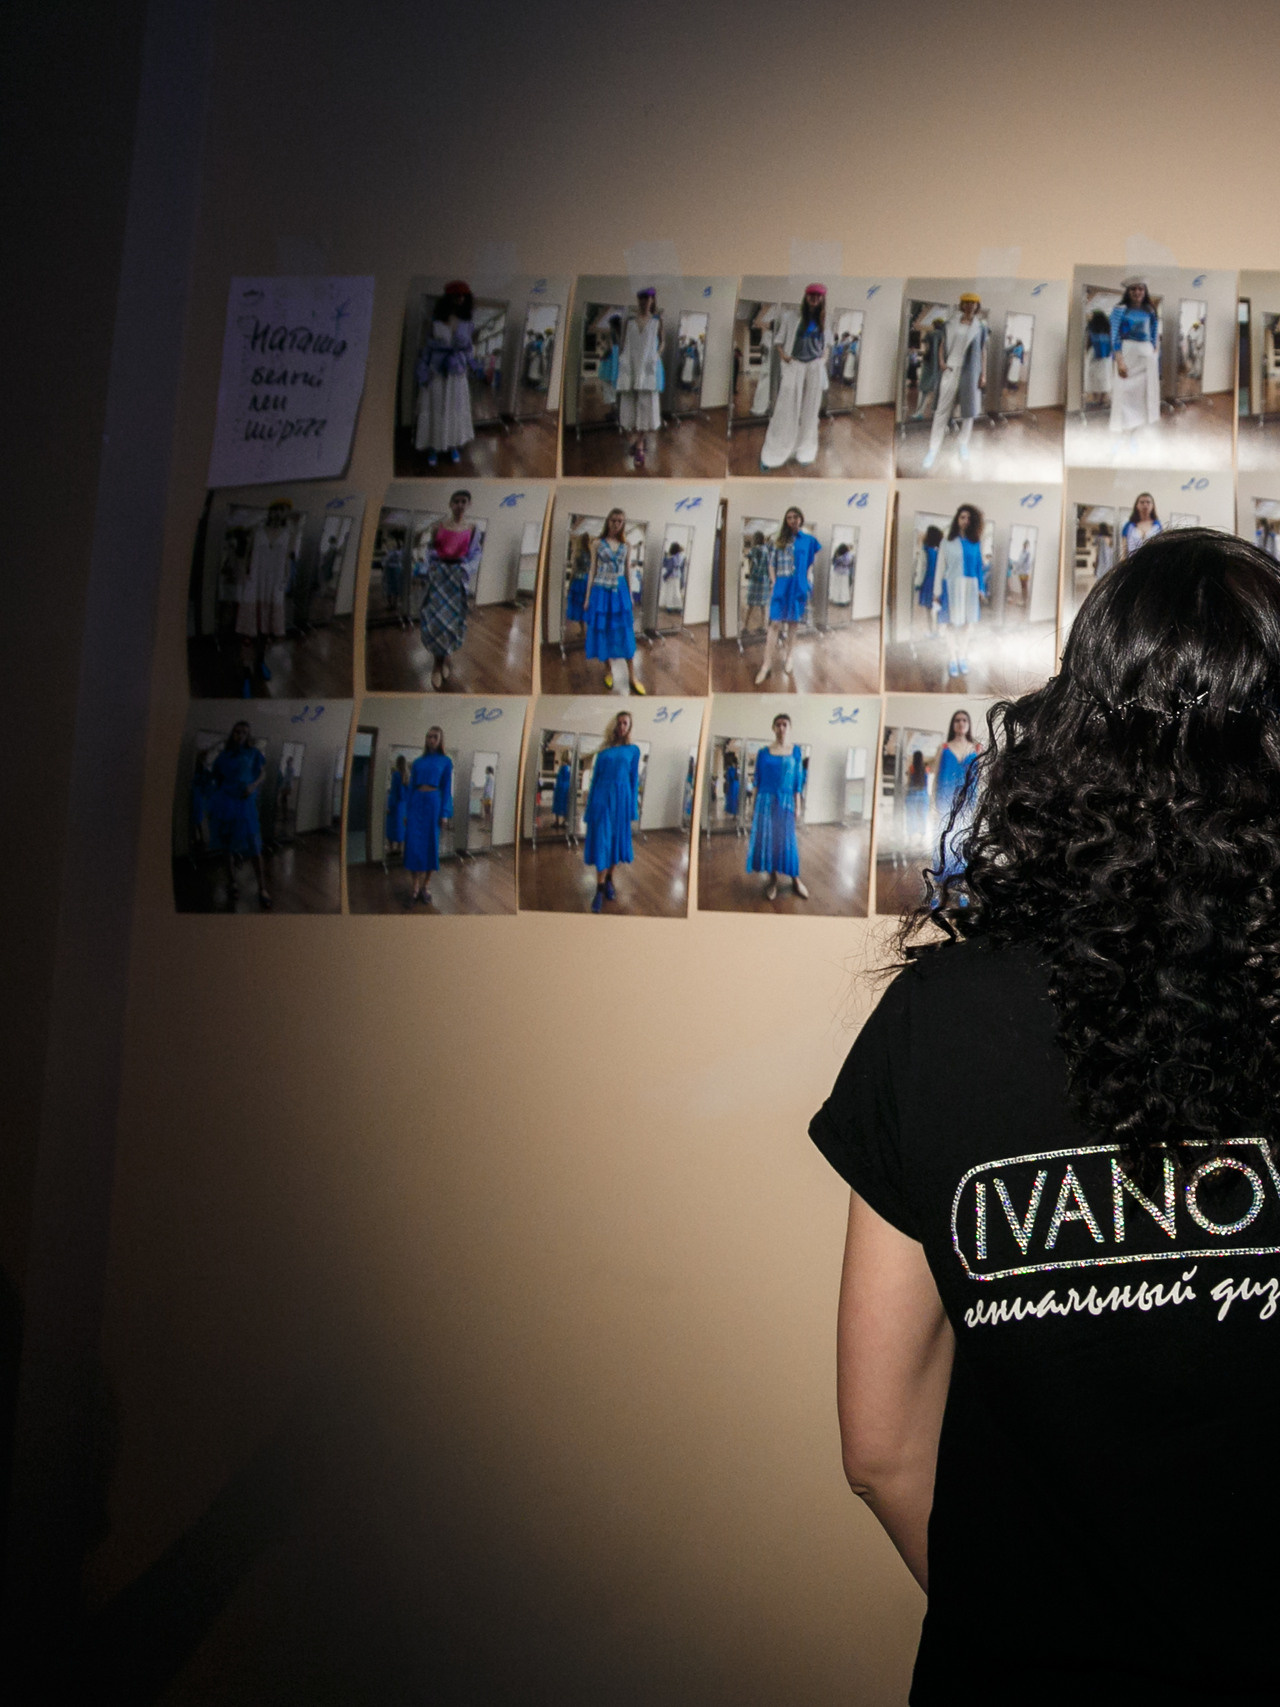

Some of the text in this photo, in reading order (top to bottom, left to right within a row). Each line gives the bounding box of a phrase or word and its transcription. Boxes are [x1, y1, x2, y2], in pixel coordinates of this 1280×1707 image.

[1192, 274, 1207, 289] 6
[1181, 477, 1210, 492] 20
[847, 492, 870, 509] 18
[1020, 492, 1044, 509] 19
[290, 704, 326, 724] 29
[471, 706, 503, 725] 30
[653, 706, 684, 723] 31
[827, 706, 860, 725] 32
[964, 1265, 1197, 1328] гениальный
